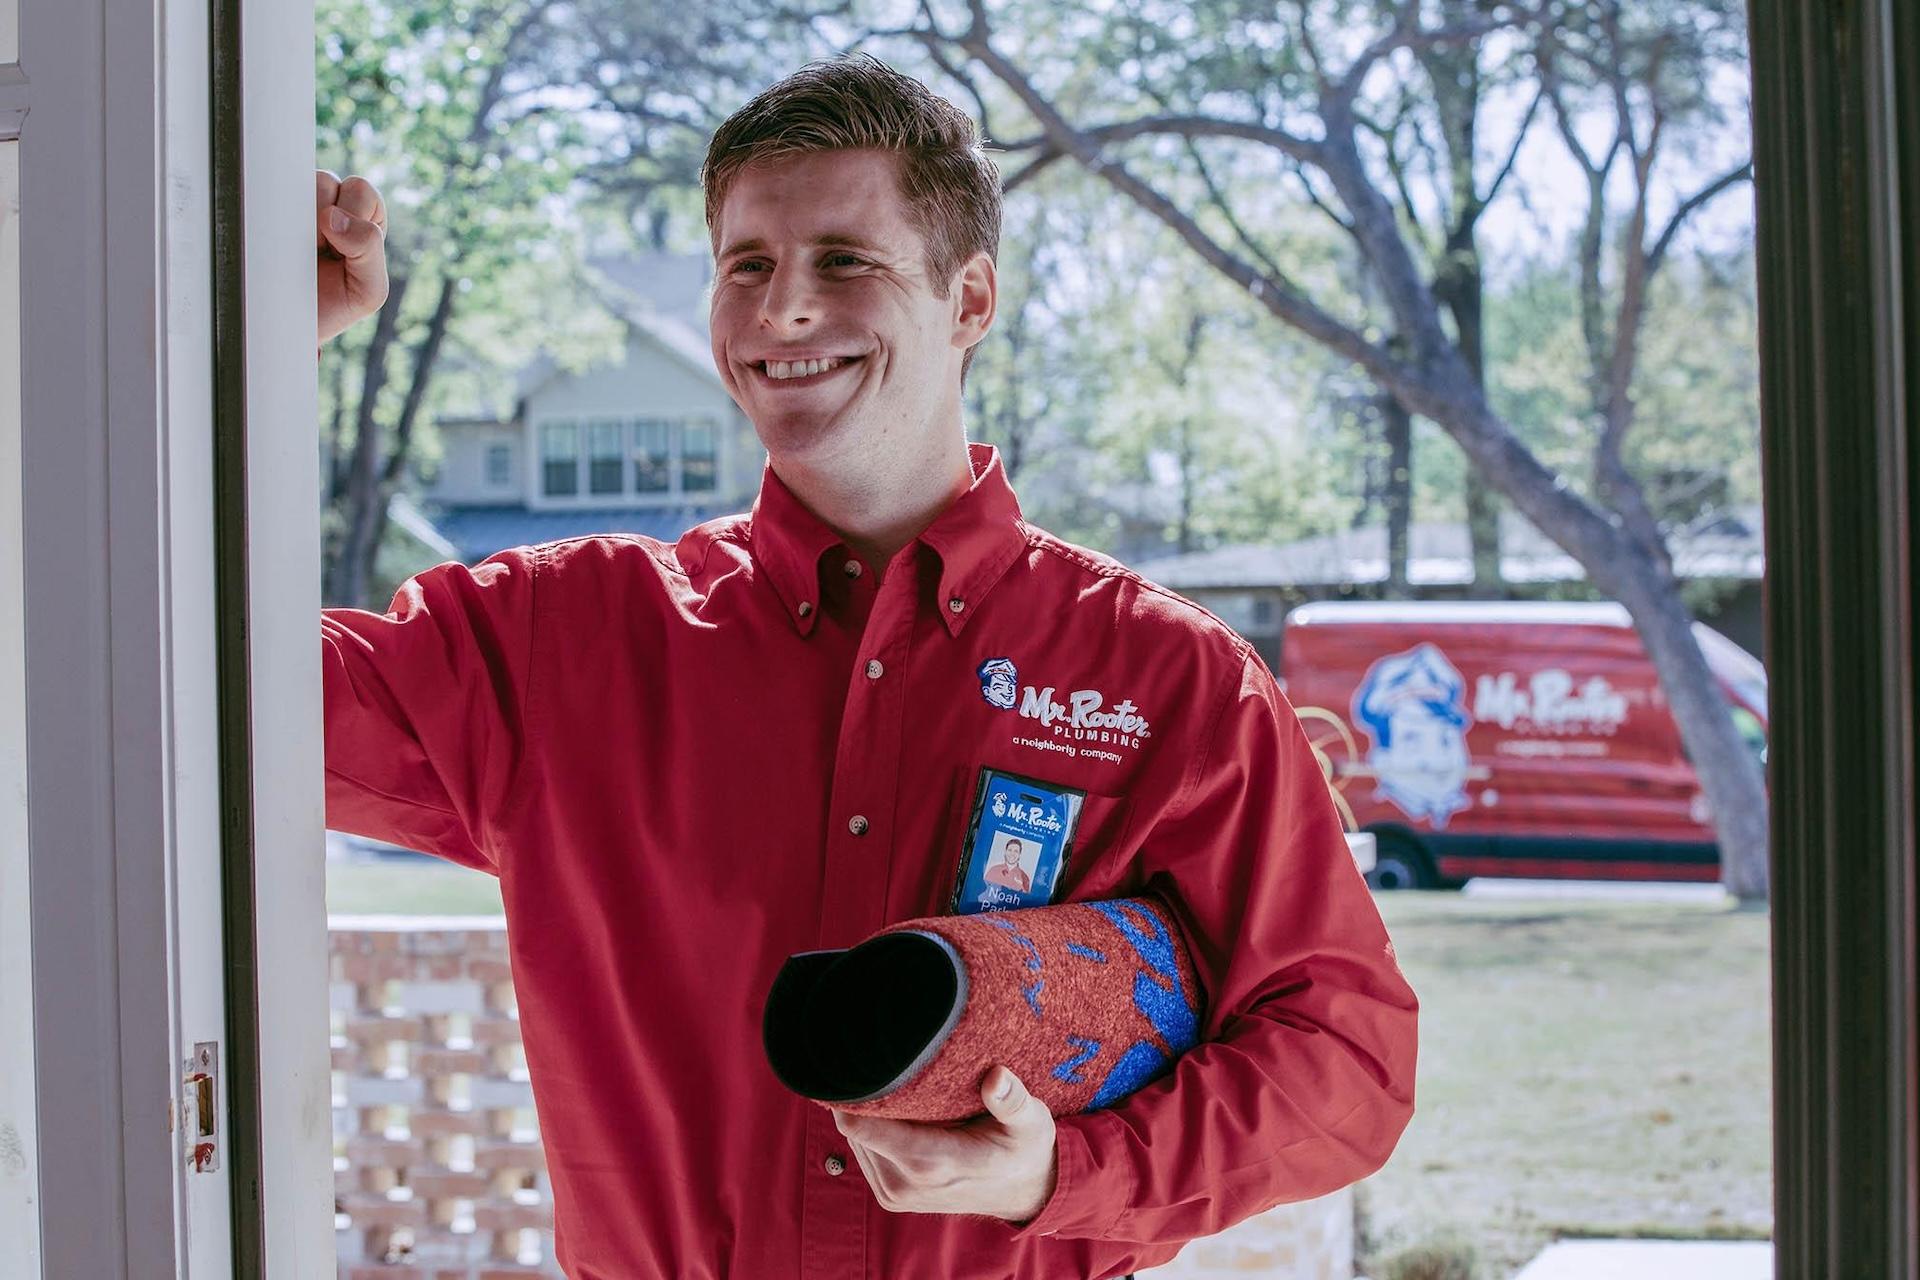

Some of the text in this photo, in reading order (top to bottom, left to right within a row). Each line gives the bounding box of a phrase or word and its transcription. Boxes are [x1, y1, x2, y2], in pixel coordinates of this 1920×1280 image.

[1019, 686, 1149, 737] Mr. Rooter
[1012, 736, 1122, 765] a neighborly company
[1054, 725, 1140, 750] PLUMBING
[1007, 802, 1029, 823] Mr.
[1028, 807, 1062, 832] Rooter
[988, 886, 1021, 906] Noah
